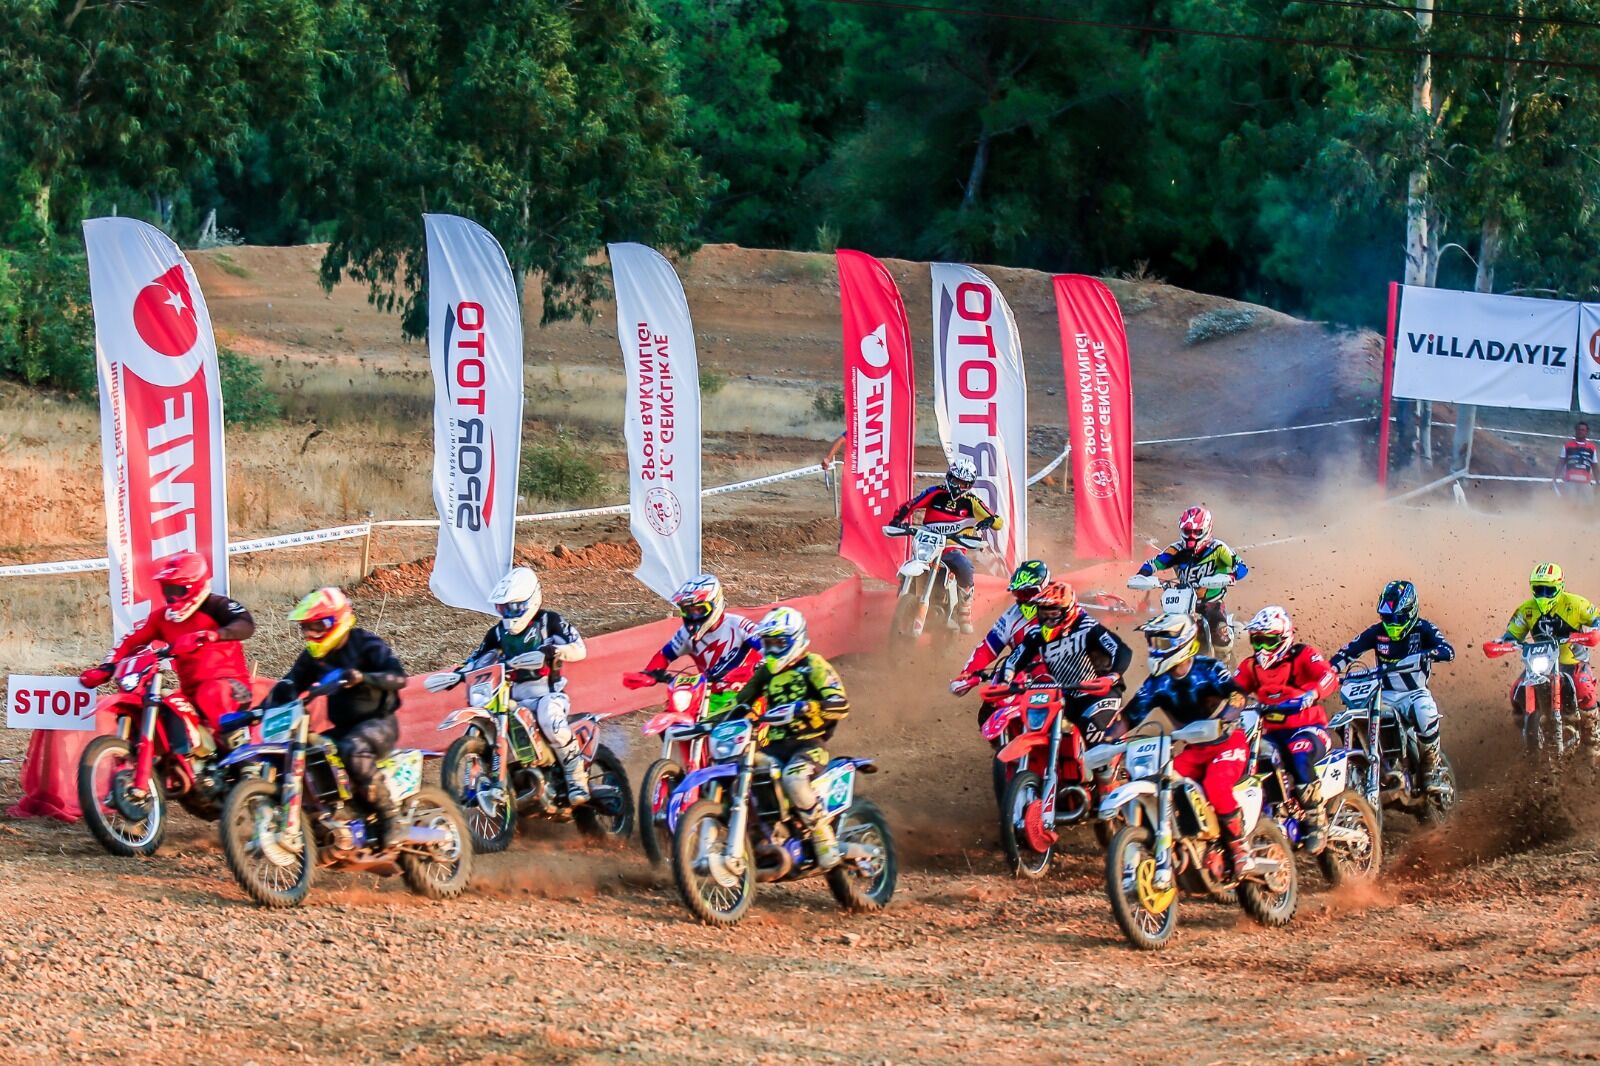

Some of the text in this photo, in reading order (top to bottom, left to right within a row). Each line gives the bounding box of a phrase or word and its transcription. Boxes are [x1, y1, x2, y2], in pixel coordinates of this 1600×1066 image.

[1165, 596, 1180, 605] 530
[14, 689, 91, 716] STOP
[1137, 744, 1157, 753] 401
